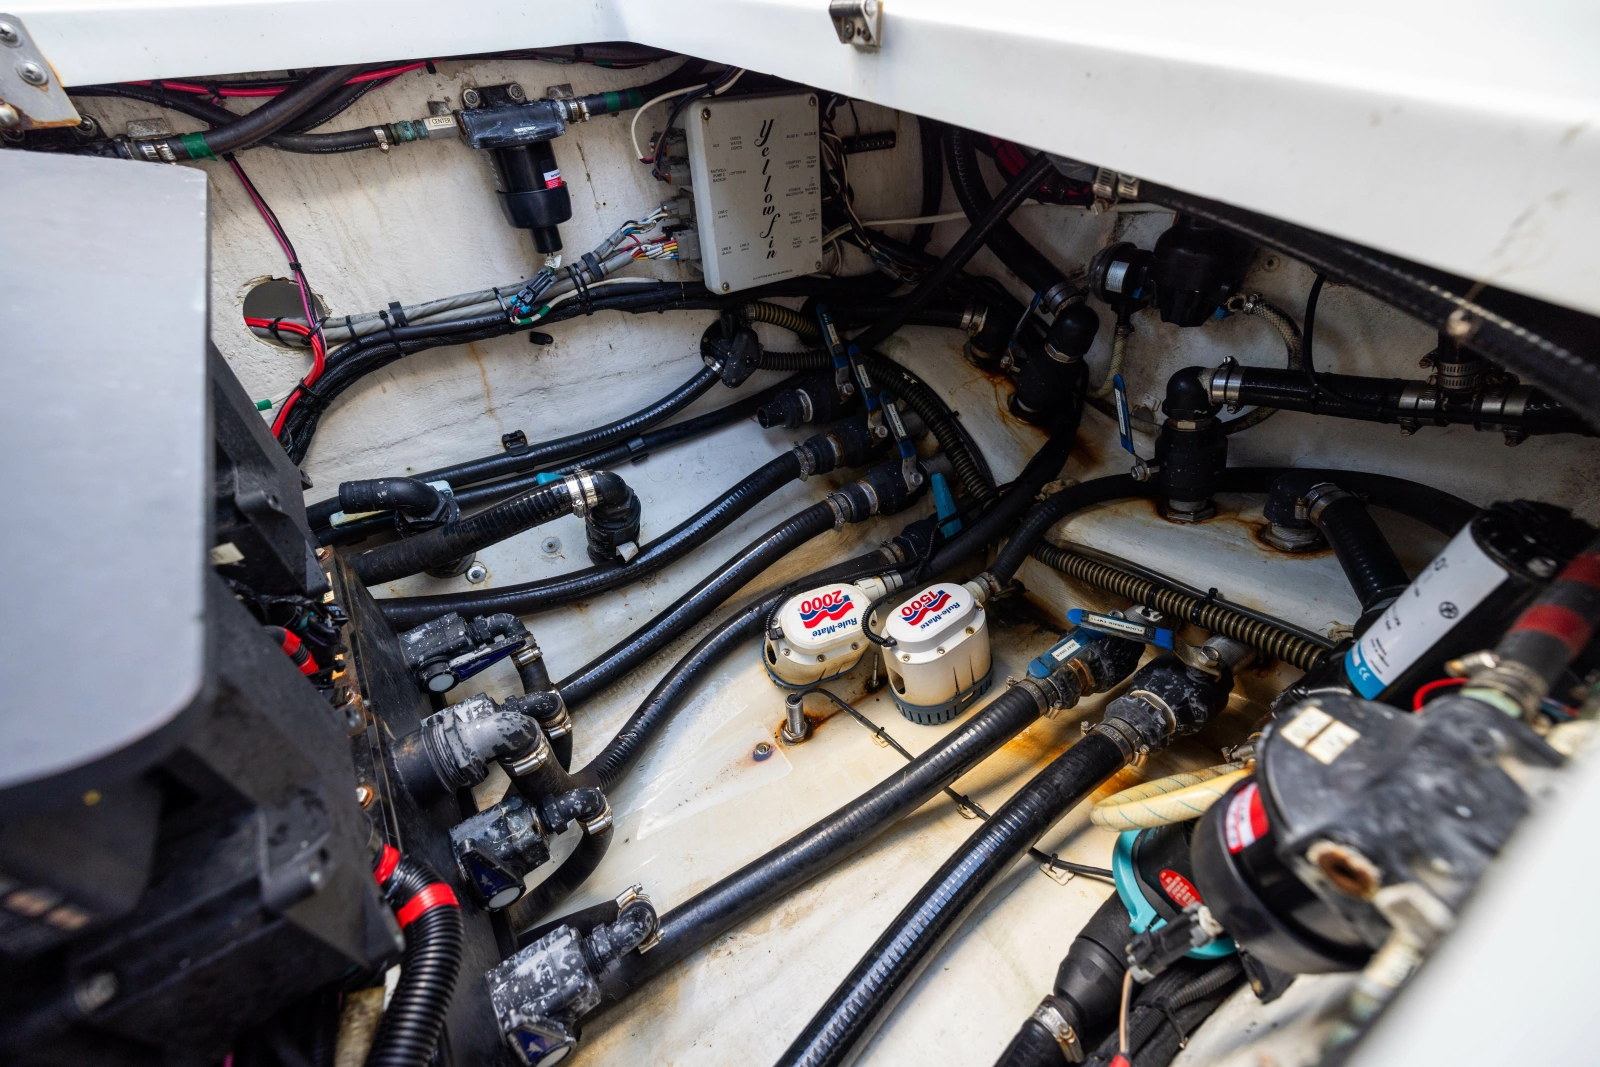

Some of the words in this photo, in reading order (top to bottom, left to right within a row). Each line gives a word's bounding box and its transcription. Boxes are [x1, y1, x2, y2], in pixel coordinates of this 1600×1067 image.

[801, 590, 842, 613] 2000
[902, 591, 938, 616] 1500
[812, 618, 858, 636] Rule-Mate
[920, 602, 960, 629] Rule-Mate
[1066, 642, 1076, 652] SEAT
